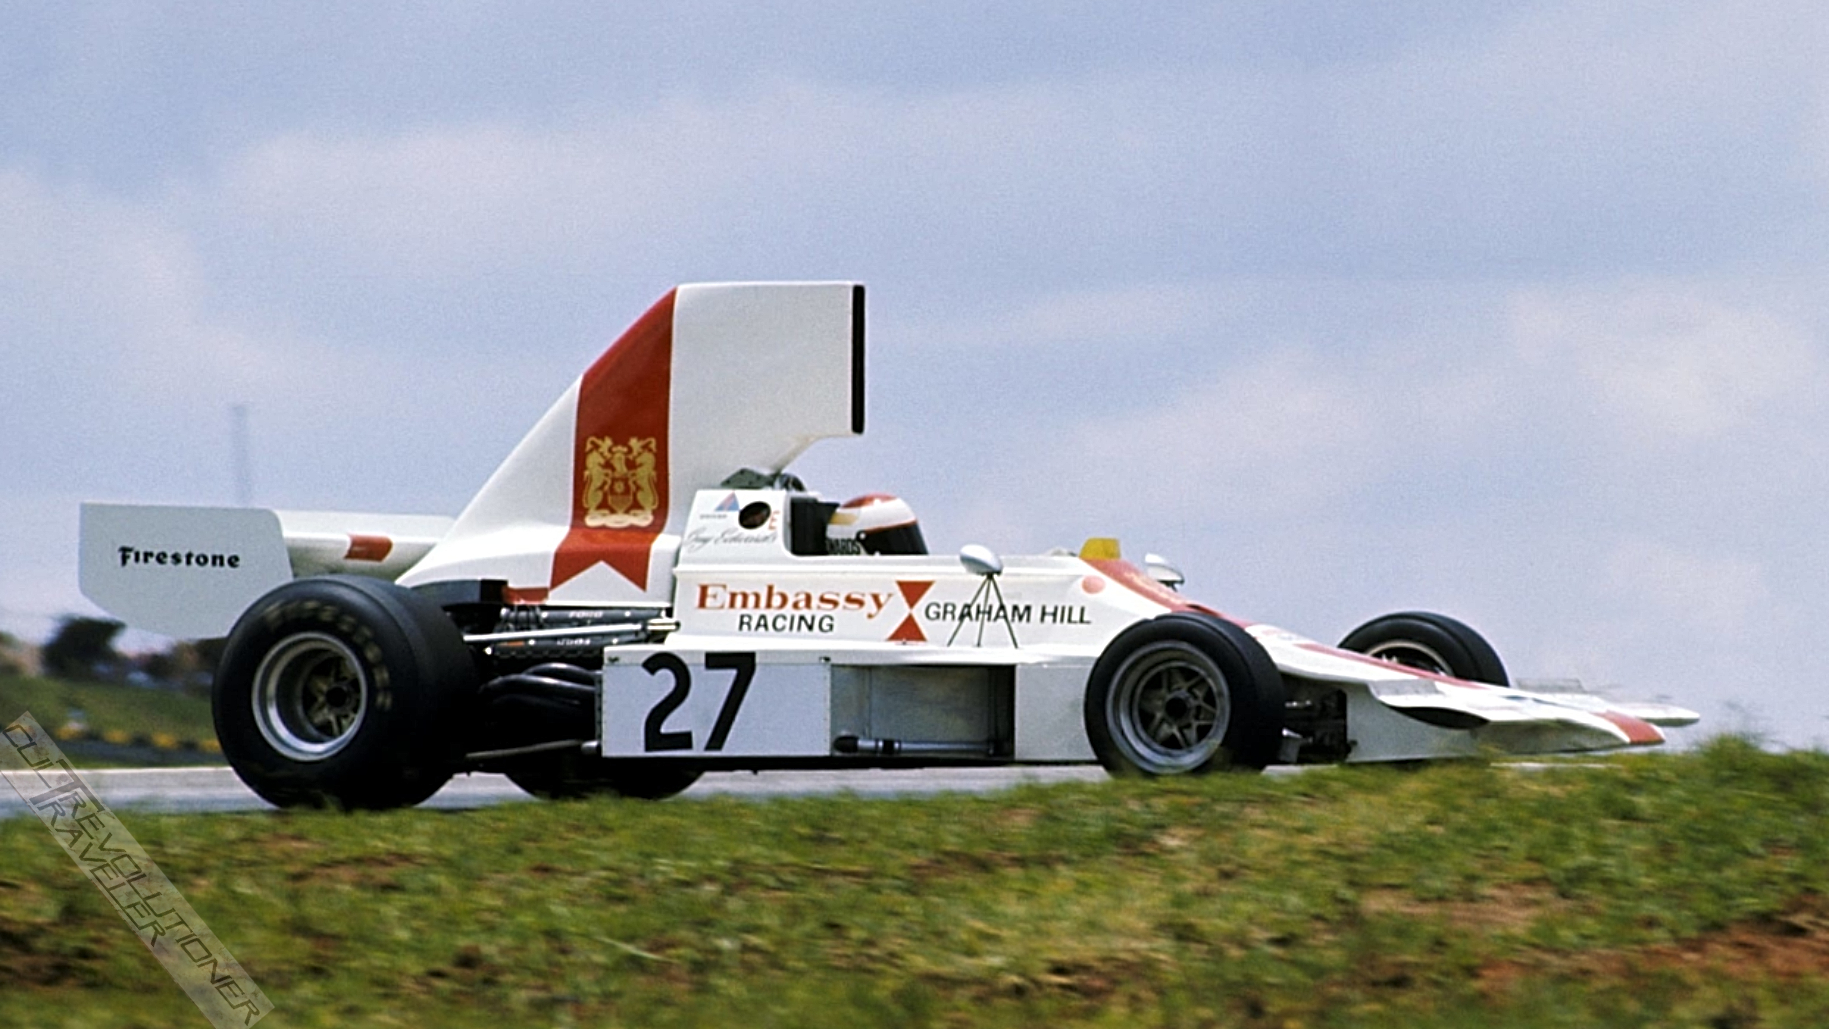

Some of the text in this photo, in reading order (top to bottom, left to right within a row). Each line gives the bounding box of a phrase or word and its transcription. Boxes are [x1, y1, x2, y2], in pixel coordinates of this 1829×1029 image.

[118, 545, 240, 568] Firestone
[696, 583, 895, 619] Embassy
[738, 614, 835, 632] RACING
[924, 602, 1092, 624] GRAHAM HILL
[642, 651, 756, 752] 27
